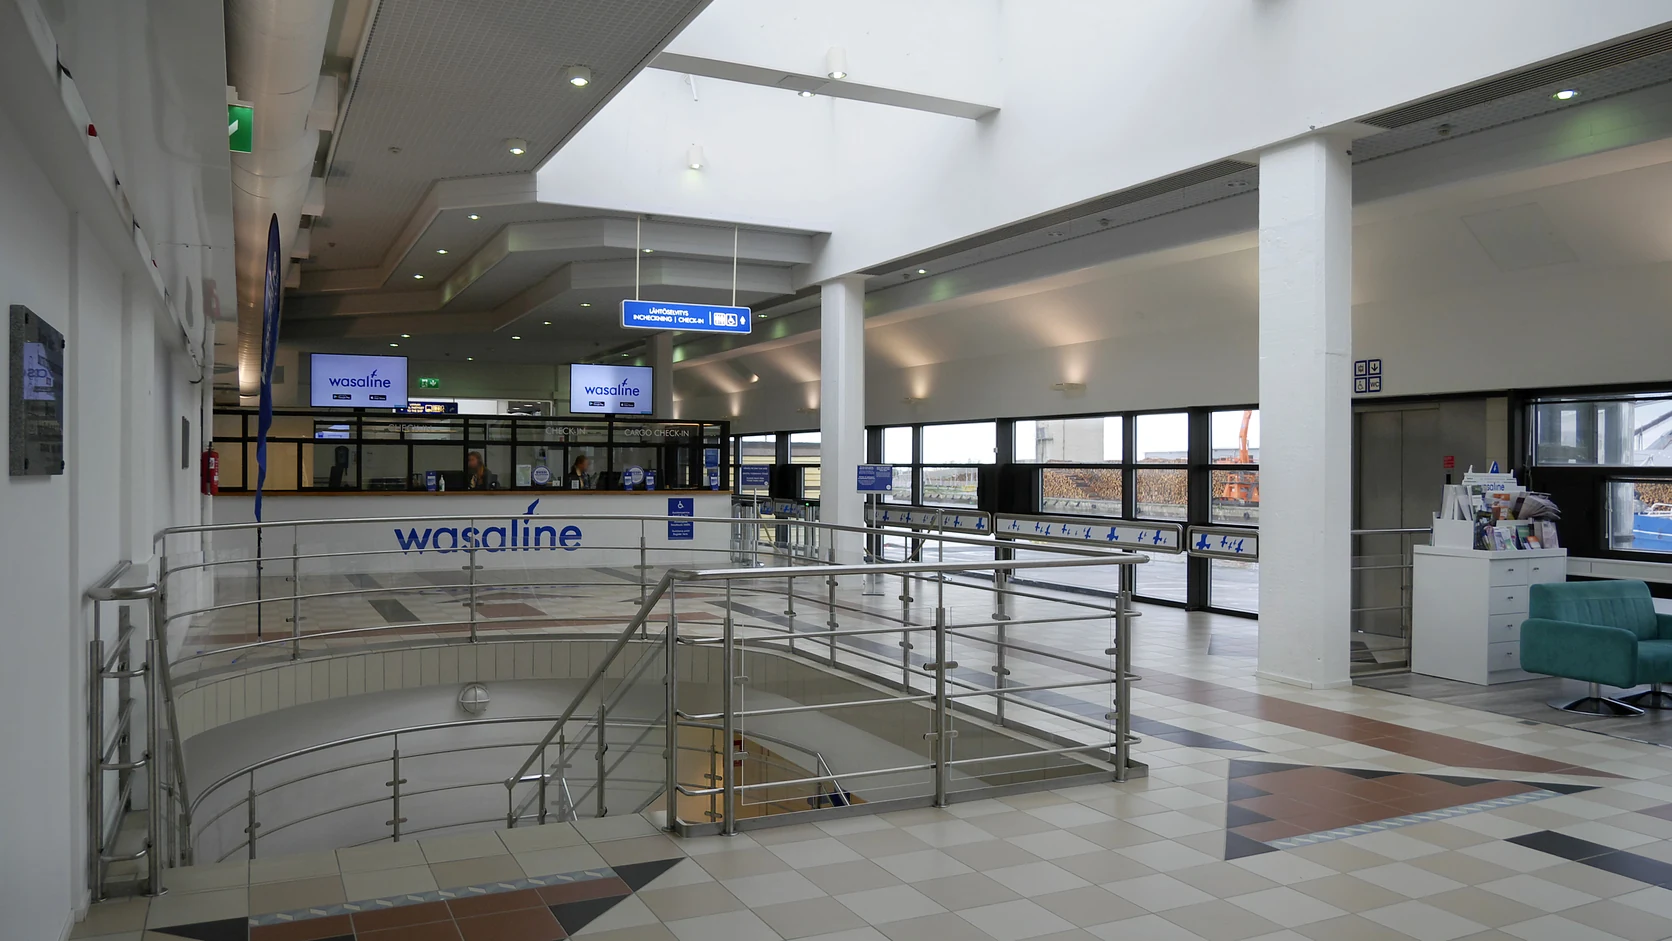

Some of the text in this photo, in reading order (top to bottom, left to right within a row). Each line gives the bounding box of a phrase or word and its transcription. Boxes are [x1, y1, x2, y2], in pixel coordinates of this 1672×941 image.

[649, 307, 689, 317] LÄHTÖSELVITYS
[633, 314, 705, 325] INCHECKNING CHECK-IN
[329, 369, 391, 388] wasaline
[585, 378, 640, 396] wasaline
[545, 427, 586, 436] CHECK-IN
[624, 428, 690, 438] CARGO CHECK-IN
[394, 499, 582, 555] wasaline
